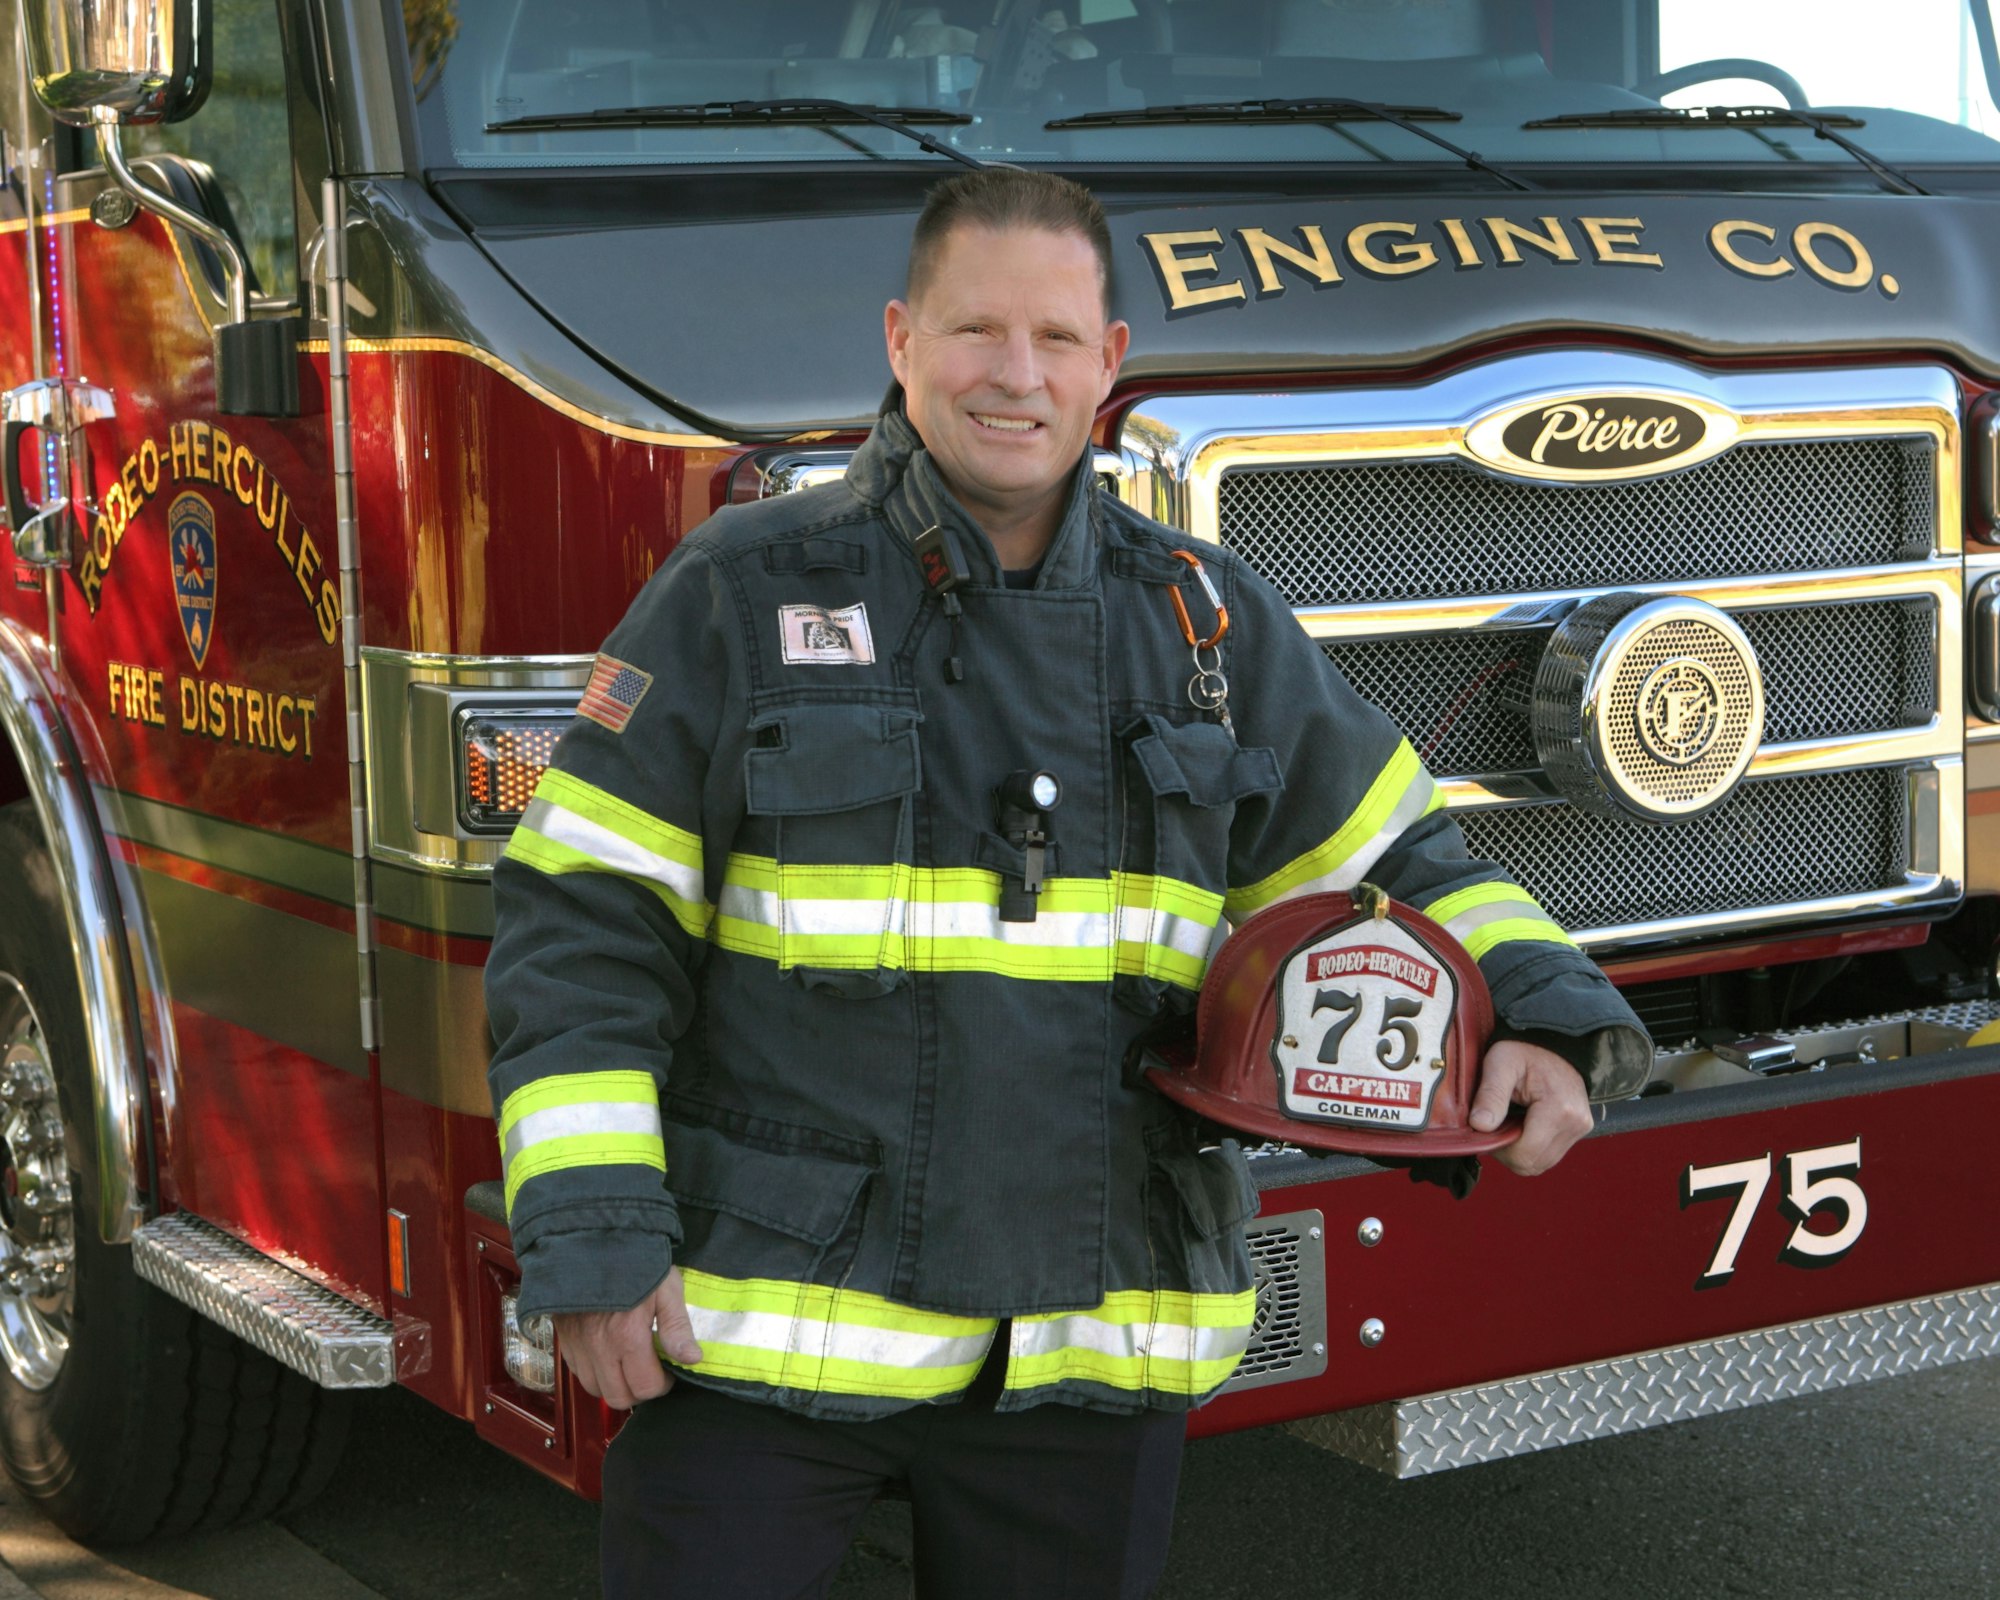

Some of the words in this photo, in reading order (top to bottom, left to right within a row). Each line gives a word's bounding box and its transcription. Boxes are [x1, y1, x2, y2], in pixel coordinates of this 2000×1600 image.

[1143, 215, 1664, 312] ENGINE
[1708, 219, 1901, 298] CO.
[1530, 403, 1681, 463] Pierce
[80, 420, 342, 646] RODEO-HERCULES
[833, 614, 854, 623] PRIDE
[107, 662, 167, 726] FIRE
[179, 676, 316, 759] DISTRICT
[1317, 950, 1431, 991] RODEO-HERCULES
[1310, 988, 1423, 1071] 75
[1307, 1072, 1410, 1101] CAPTAIN
[1317, 1102, 1401, 1121] COLEMAN
[1686, 1135, 1868, 1279] 75
